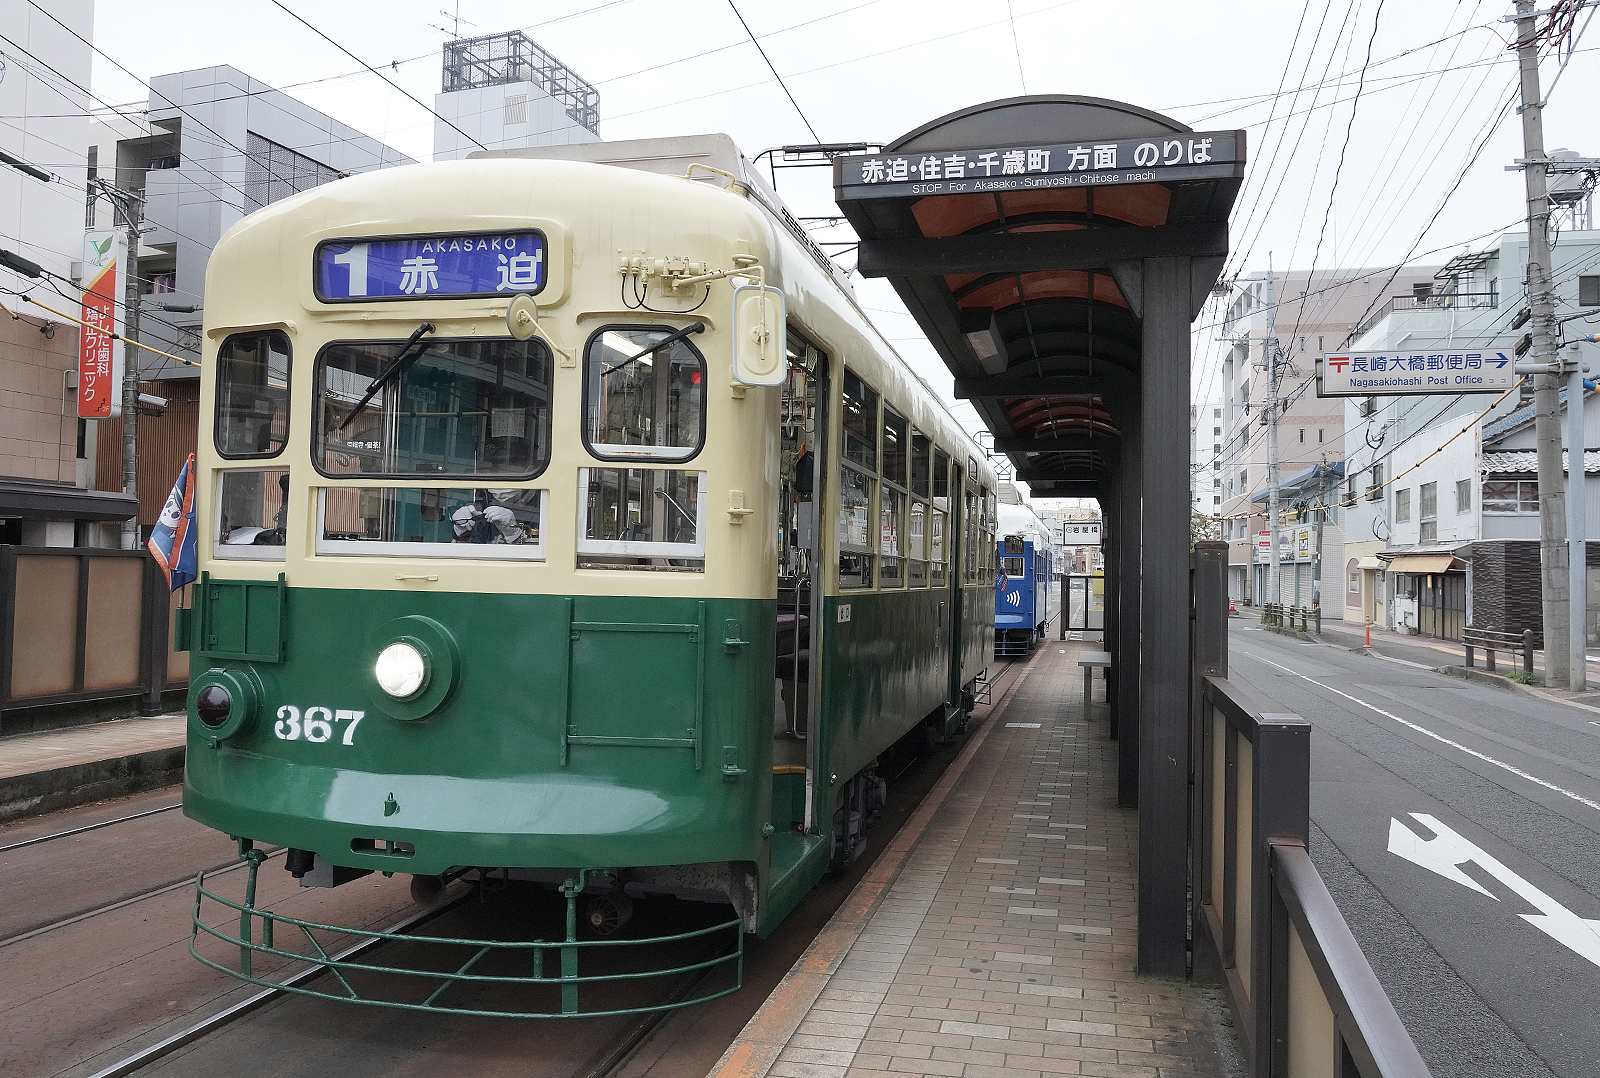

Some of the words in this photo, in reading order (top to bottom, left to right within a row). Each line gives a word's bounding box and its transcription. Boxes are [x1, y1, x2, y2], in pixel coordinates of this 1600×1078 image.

[1067, 143, 1118, 171] 方面
[1133, 137, 1213, 167] のりば
[912, 183, 942, 194] STOP
[949, 182, 967, 192] For
[1126, 170, 1156, 182] machi
[422, 237, 516, 253] AKASAKO
[334, 243, 368, 297] 1
[84, 306, 99, 402] 矯正クリニック
[1351, 353, 1482, 373] 長崎大橋郵便局
[1350, 377, 1422, 389] Nagasakiohashi
[1427, 376, 1449, 385] Post
[1454, 374, 1483, 384] Office
[274, 705, 365, 745] 367
